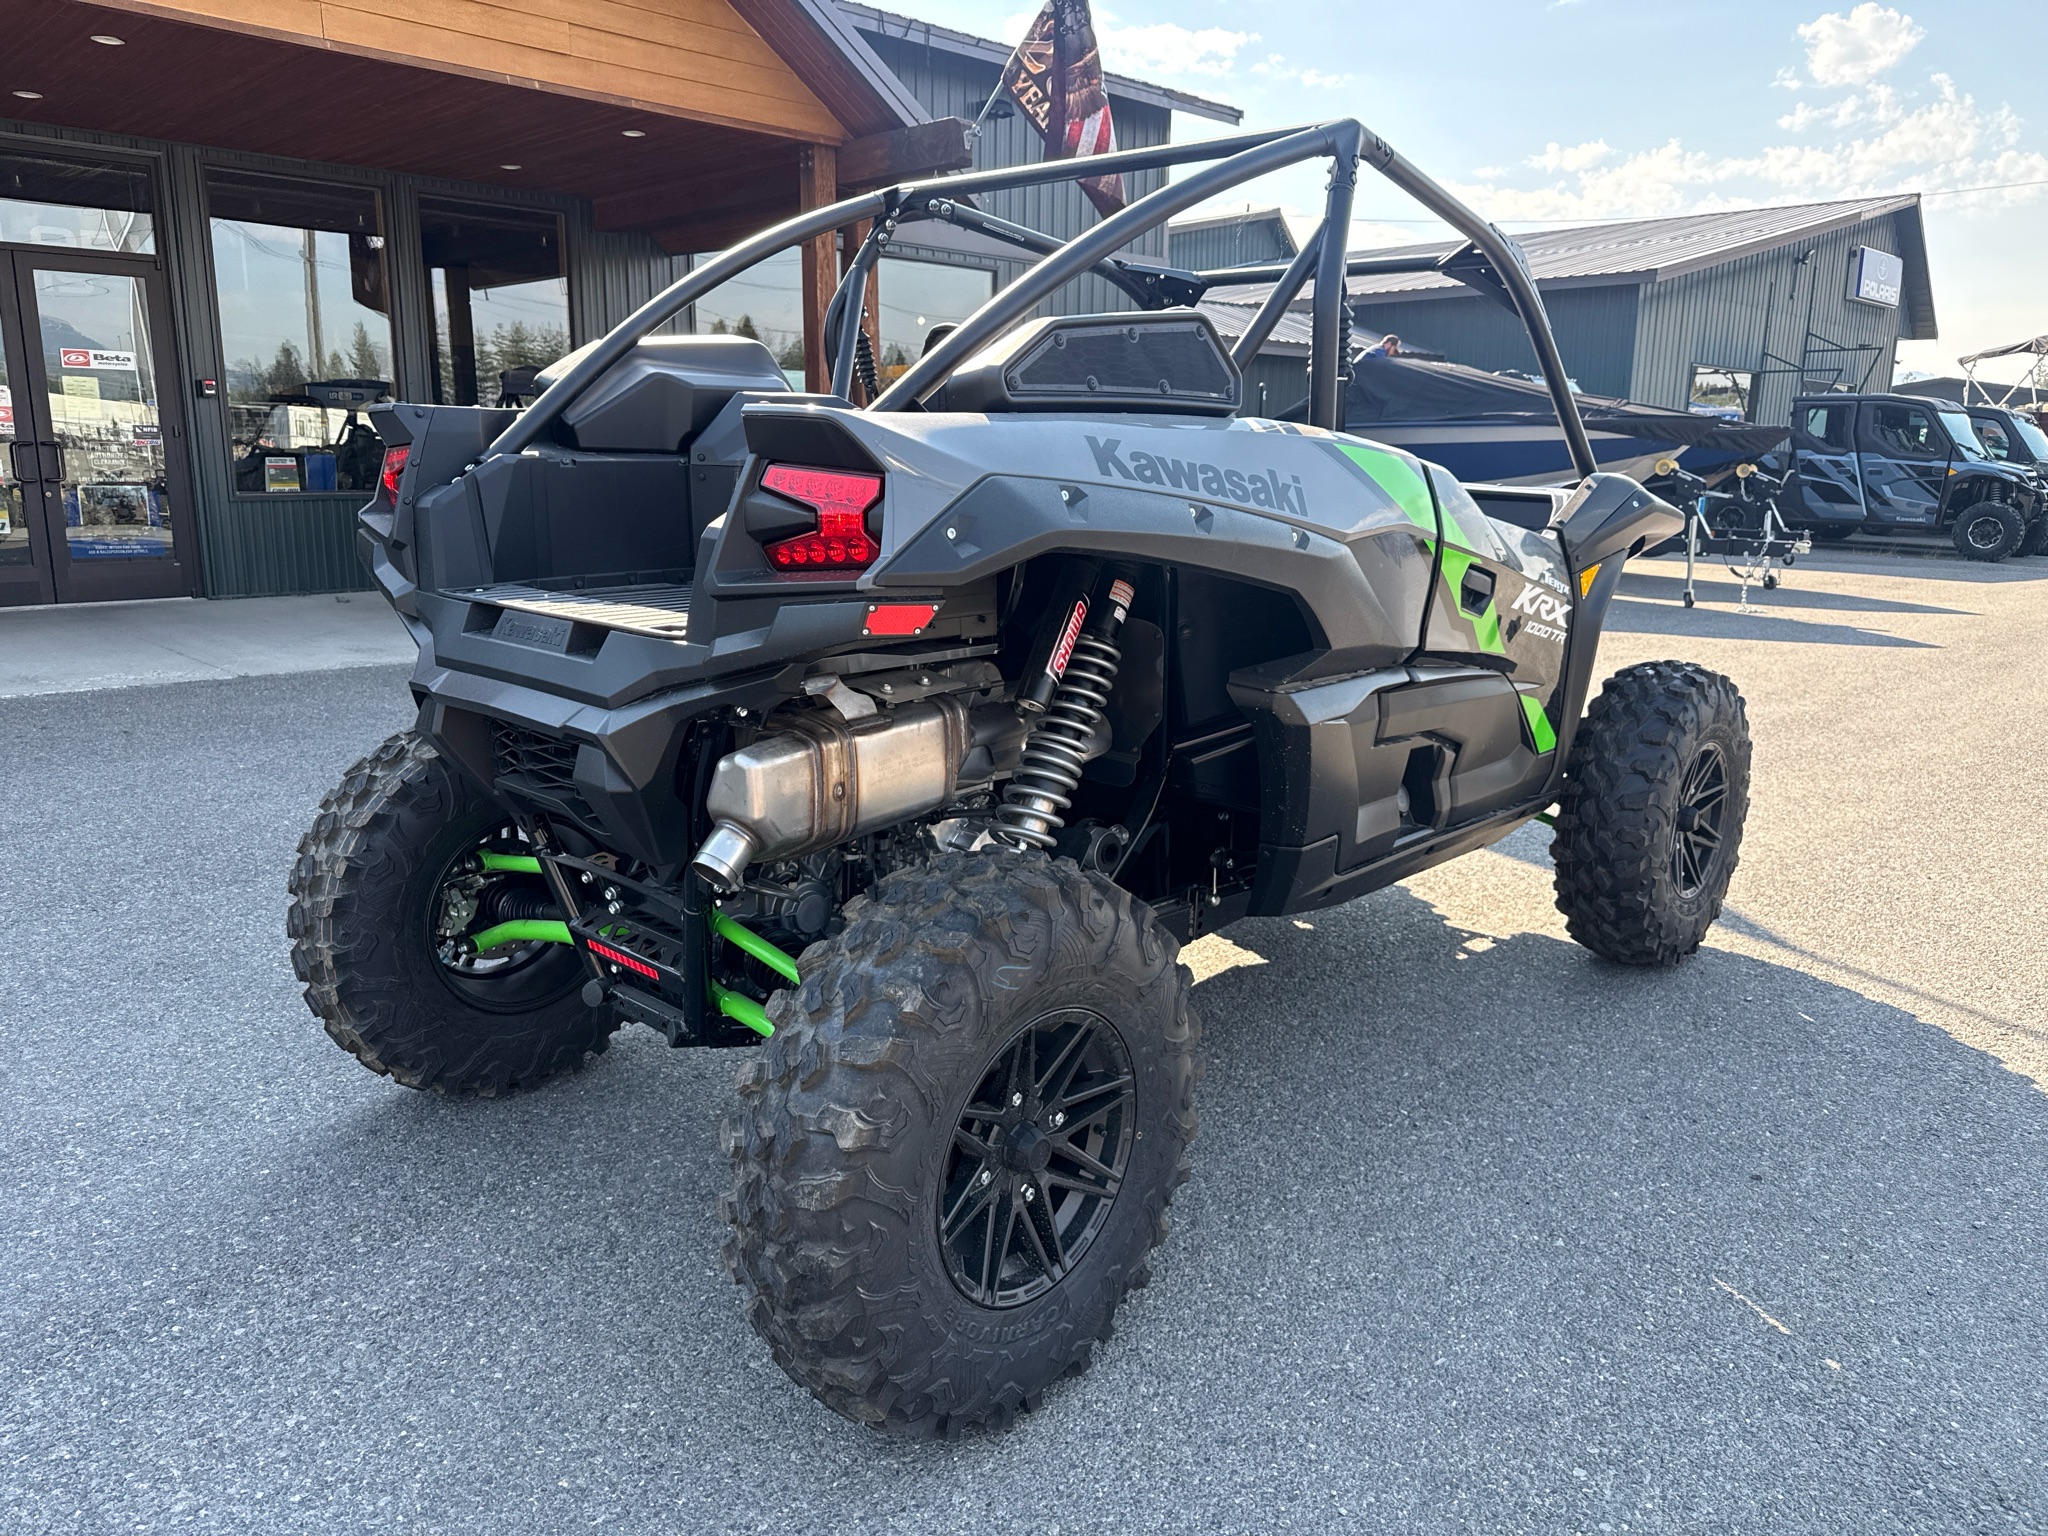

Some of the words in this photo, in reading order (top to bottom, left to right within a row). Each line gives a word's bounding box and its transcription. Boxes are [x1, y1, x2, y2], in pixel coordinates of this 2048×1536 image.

[1863, 279, 1898, 302] POLARIS
[93, 353, 131, 363] Beta
[1084, 435, 1309, 518] Kawasaki
[1542, 570, 1570, 595] TERYX
[1511, 582, 1573, 628] KRX
[499, 617, 566, 646] Kawasaki
[1053, 600, 1087, 679] SHOWA
[944, 1305, 1060, 1344] CARNIVORE
